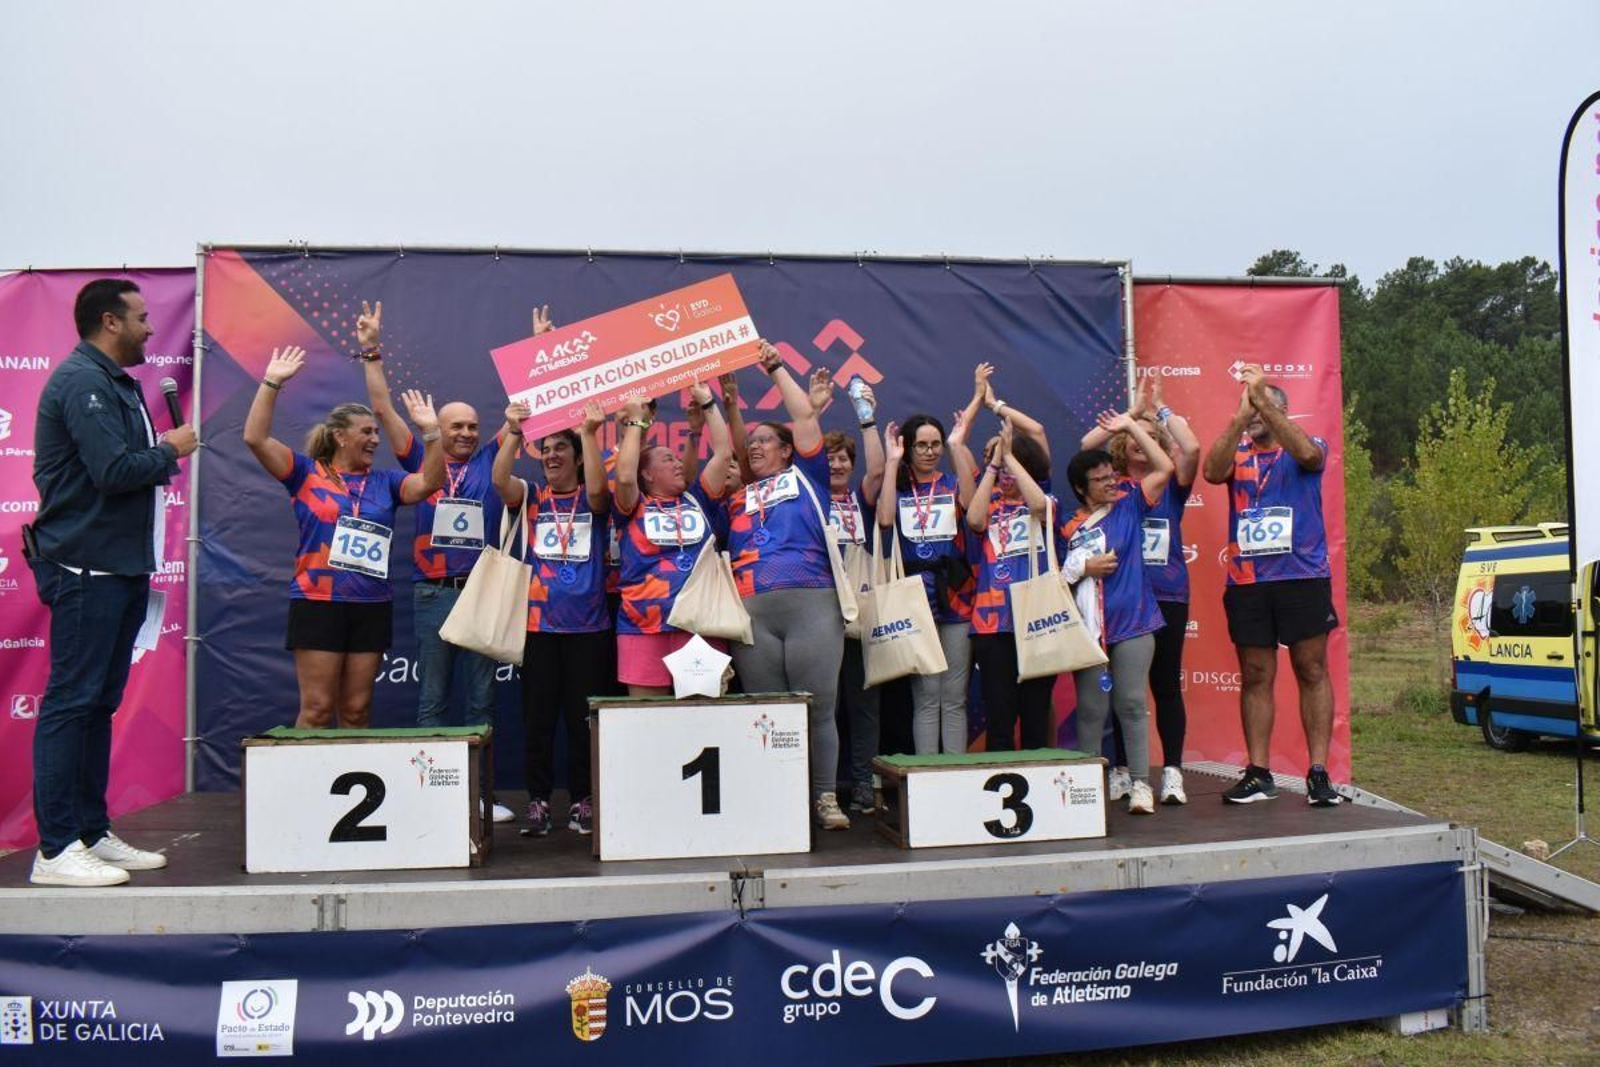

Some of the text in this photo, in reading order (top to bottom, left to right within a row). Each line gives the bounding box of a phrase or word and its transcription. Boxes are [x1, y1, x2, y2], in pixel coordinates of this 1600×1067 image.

[145, 354, 193, 367] vigo.ne
[535, 359, 647, 409] APORTACIÓN
[649, 337, 736, 372] SOLIDARIA
[618, 386, 647, 402] activa
[666, 359, 721, 384] oportunidad
[1161, 366, 1200, 377] Censa
[453, 512, 469, 532] 6
[648, 514, 697, 533] 130
[1241, 522, 1283, 543] 169
[338, 533, 383, 562] 156
[543, 528, 577, 548] 64
[872, 618, 912, 638] AEMOS
[1027, 610, 1070, 633] AEMOS
[1489, 643, 1533, 659] LANCIA
[682, 747, 720, 815] 1
[329, 771, 387, 843] 2
[983, 772, 1033, 838] 3
[1004, 939, 1021, 948] FGA
[1029, 961, 1178, 986] Federación Galega
[1222, 959, 1383, 994] Fundación "la Caixa"
[626, 976, 733, 994] CONCELLO DE
[1031, 984, 1131, 1007] de Atletismo
[39, 1000, 117, 1019] XUNTA
[414, 990, 515, 1013] Deputación
[626, 988, 734, 1026] MOS
[412, 1009, 515, 1027] Pontevedra
[783, 1001, 841, 1024] grupo
[40, 1022, 165, 1041] DE GALICIA
[221, 1024, 247, 1033] Pacto
[258, 1023, 290, 1032] Estado
